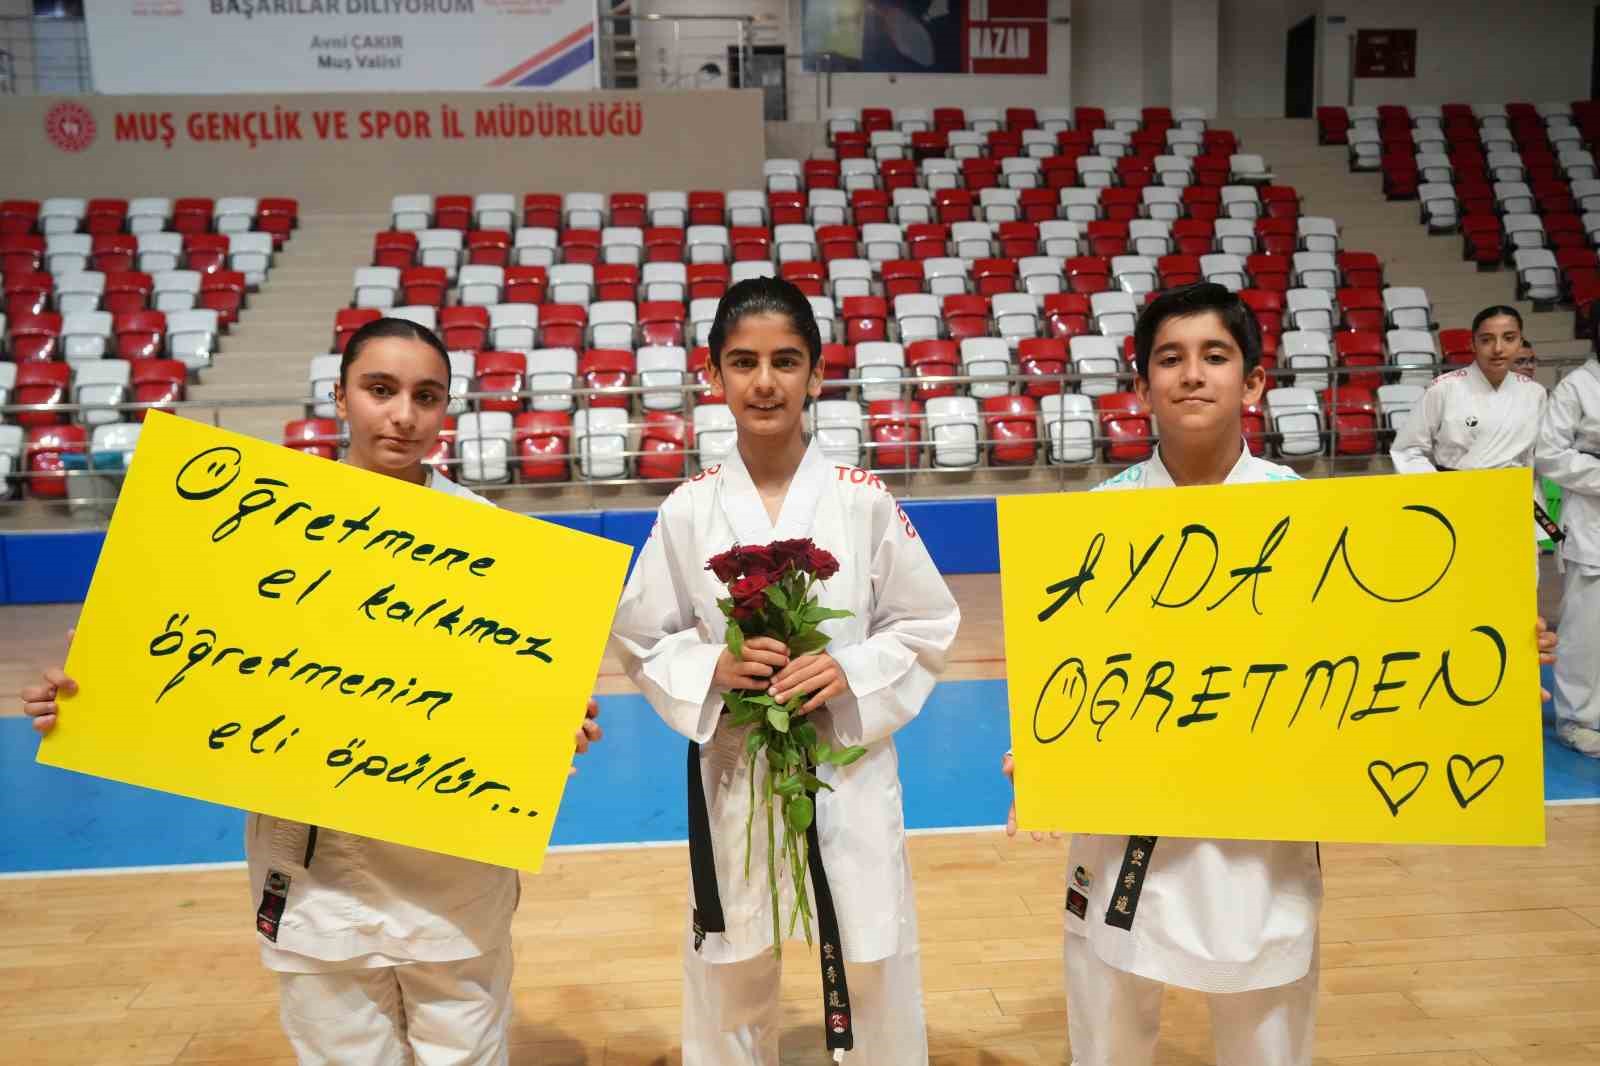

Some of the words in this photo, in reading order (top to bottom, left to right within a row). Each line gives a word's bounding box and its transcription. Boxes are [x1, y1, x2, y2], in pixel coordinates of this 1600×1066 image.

[317, 55, 352, 70] Muş
[114, 111, 176, 148] MUŞ
[186, 106, 302, 148] GENÇLİK
[313, 111, 348, 141] VE
[359, 109, 432, 140] SPOR
[441, 103, 465, 140] İL
[474, 101, 645, 139] MÜDÜRLÜĞÜ
[1037, 505, 1457, 622] AYDAN
[257, 569, 332, 605] el
[358, 583, 553, 664] kalkmaz
[149, 613, 453, 721] öğretmenin
[1032, 625, 1507, 745] ÖĞRETMEN
[208, 714, 300, 754] eli
